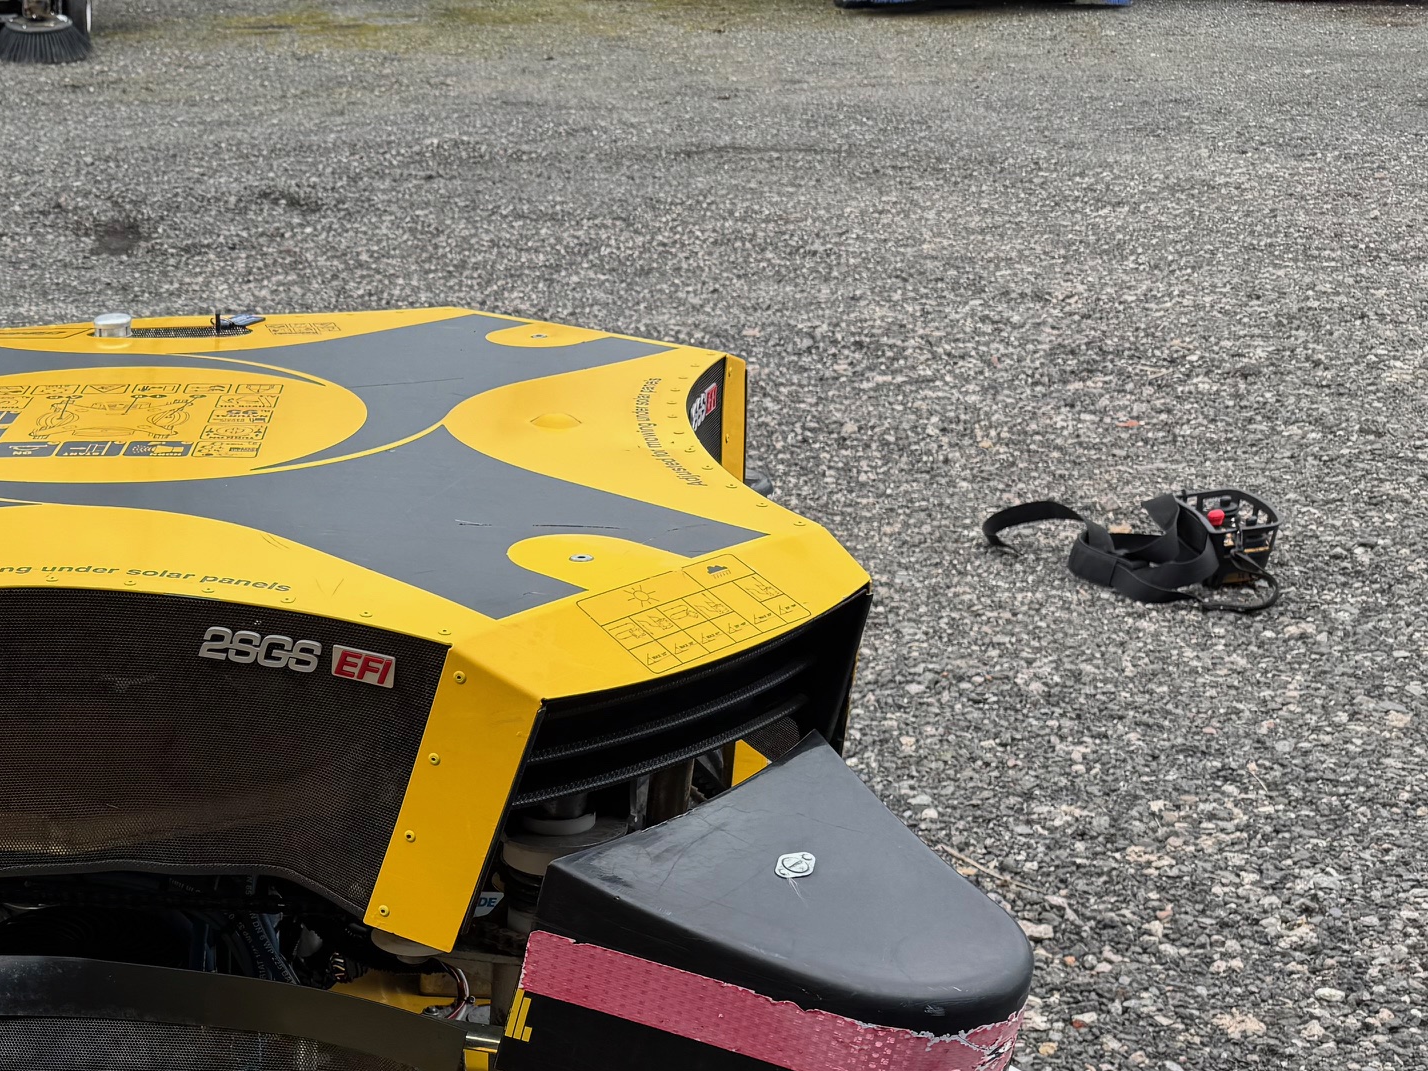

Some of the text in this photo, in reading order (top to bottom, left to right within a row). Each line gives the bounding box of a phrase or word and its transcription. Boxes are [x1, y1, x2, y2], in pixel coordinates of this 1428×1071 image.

[636, 423, 662, 448] mowing
[41, 565, 119, 575] under
[126, 568, 196, 581] solar
[199, 574, 291, 593] panels
[198, 626, 393, 685] 2SGS EFI
